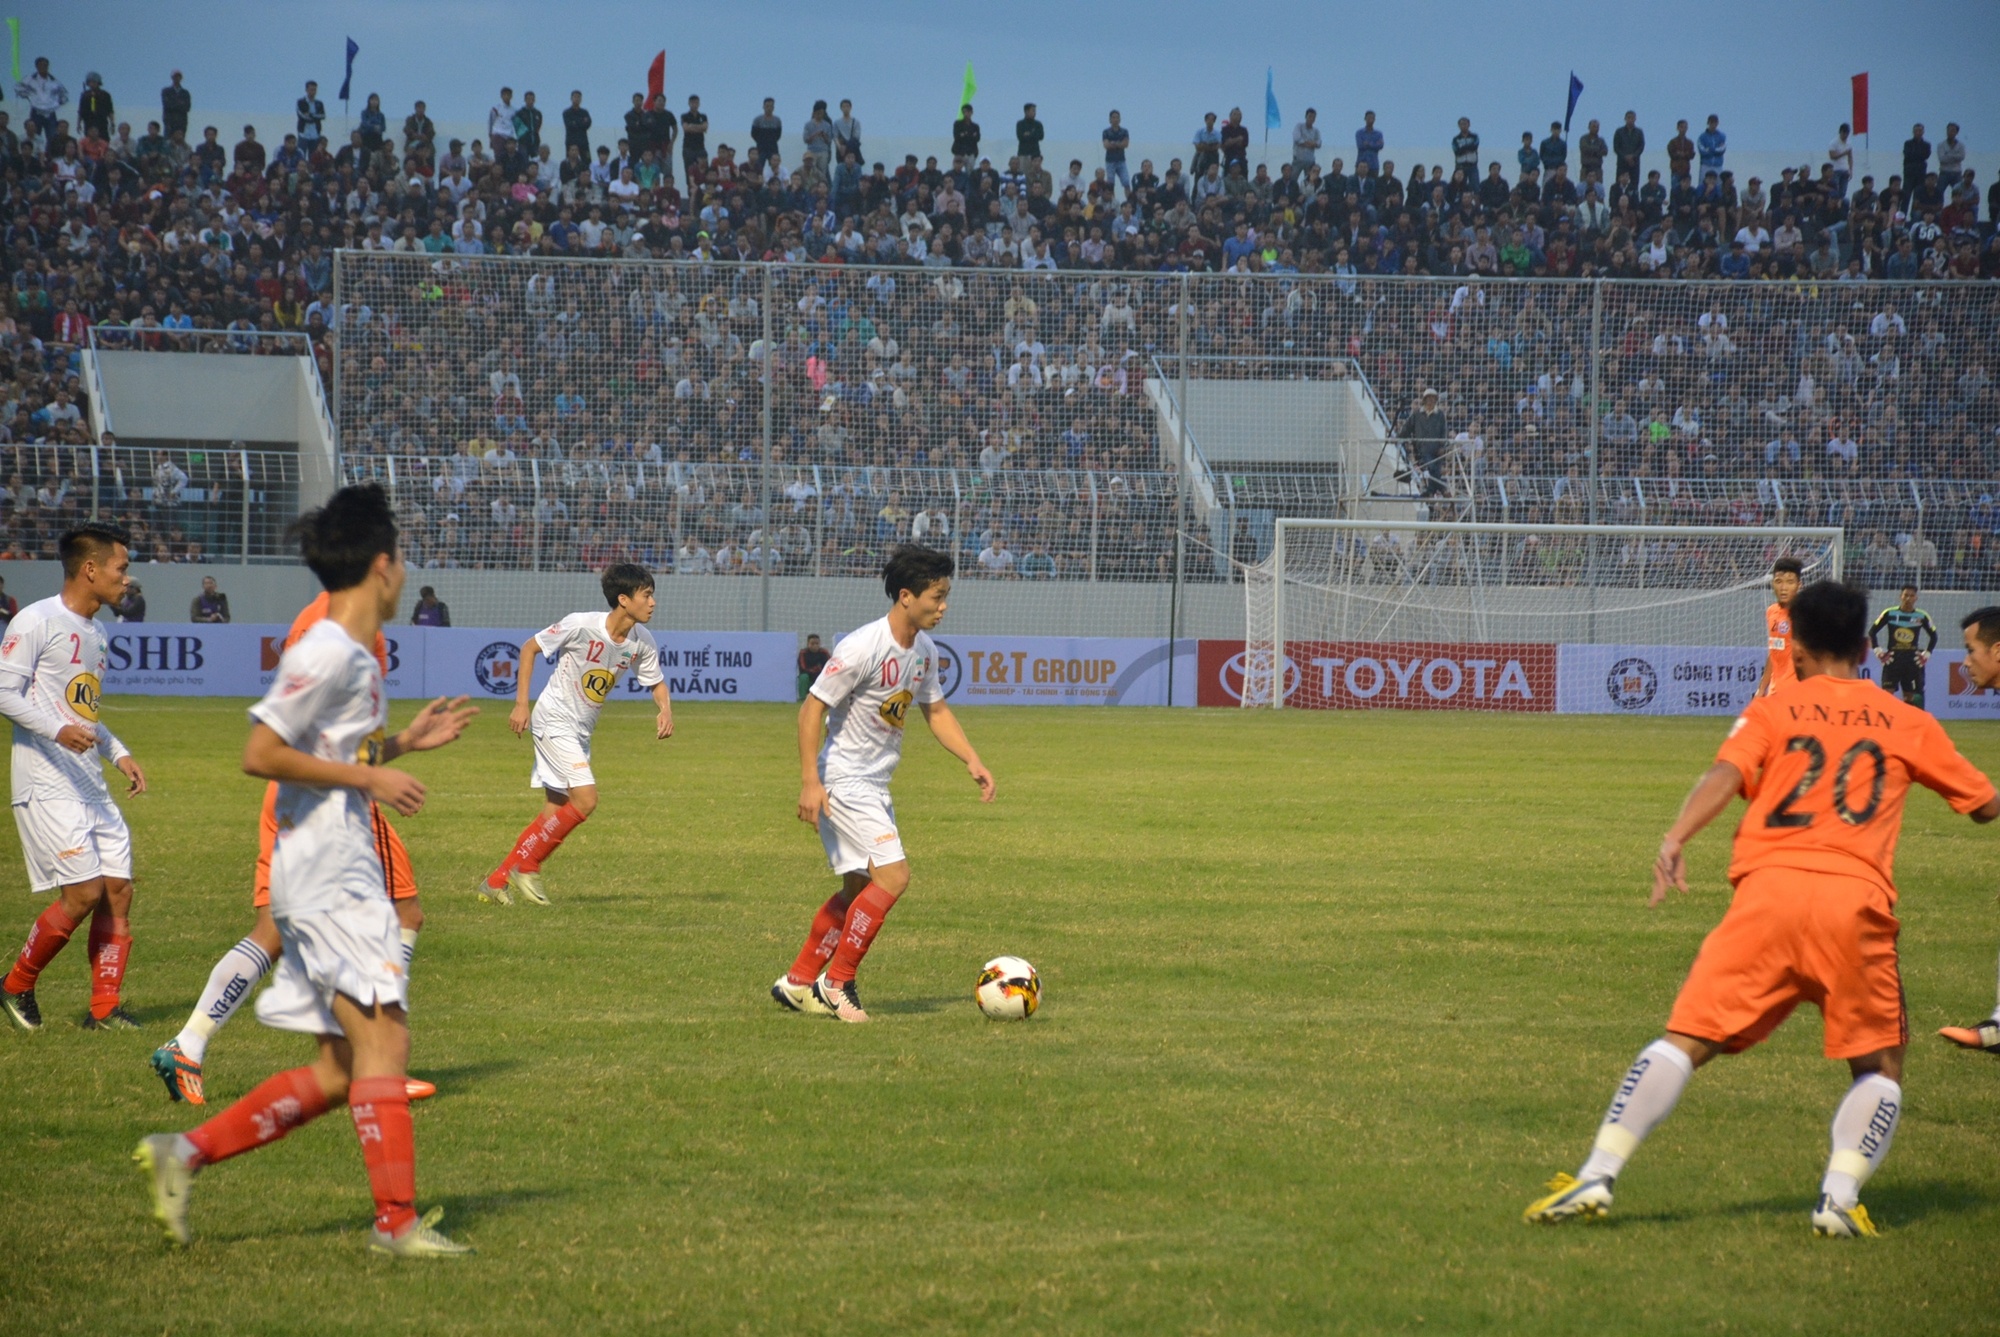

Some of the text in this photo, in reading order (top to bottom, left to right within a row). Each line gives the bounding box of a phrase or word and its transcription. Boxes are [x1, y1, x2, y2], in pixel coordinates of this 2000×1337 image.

[69, 632, 82, 664] 2
[107, 634, 204, 671] SHB
[586, 640, 605, 664] 12
[683, 643, 711, 667] THỂ
[715, 651, 752, 668] THAO
[670, 668, 738, 694] NẴNG
[880, 657, 899, 688] 10
[967, 651, 1117, 684] T&T GROUP
[1311, 657, 1533, 700] TOYOTA
[1673, 661, 1713, 682] CÔNG
[1717, 664, 1733, 682] TY
[1686, 691, 1731, 708] SHB
[1765, 733, 1887, 828] 20
